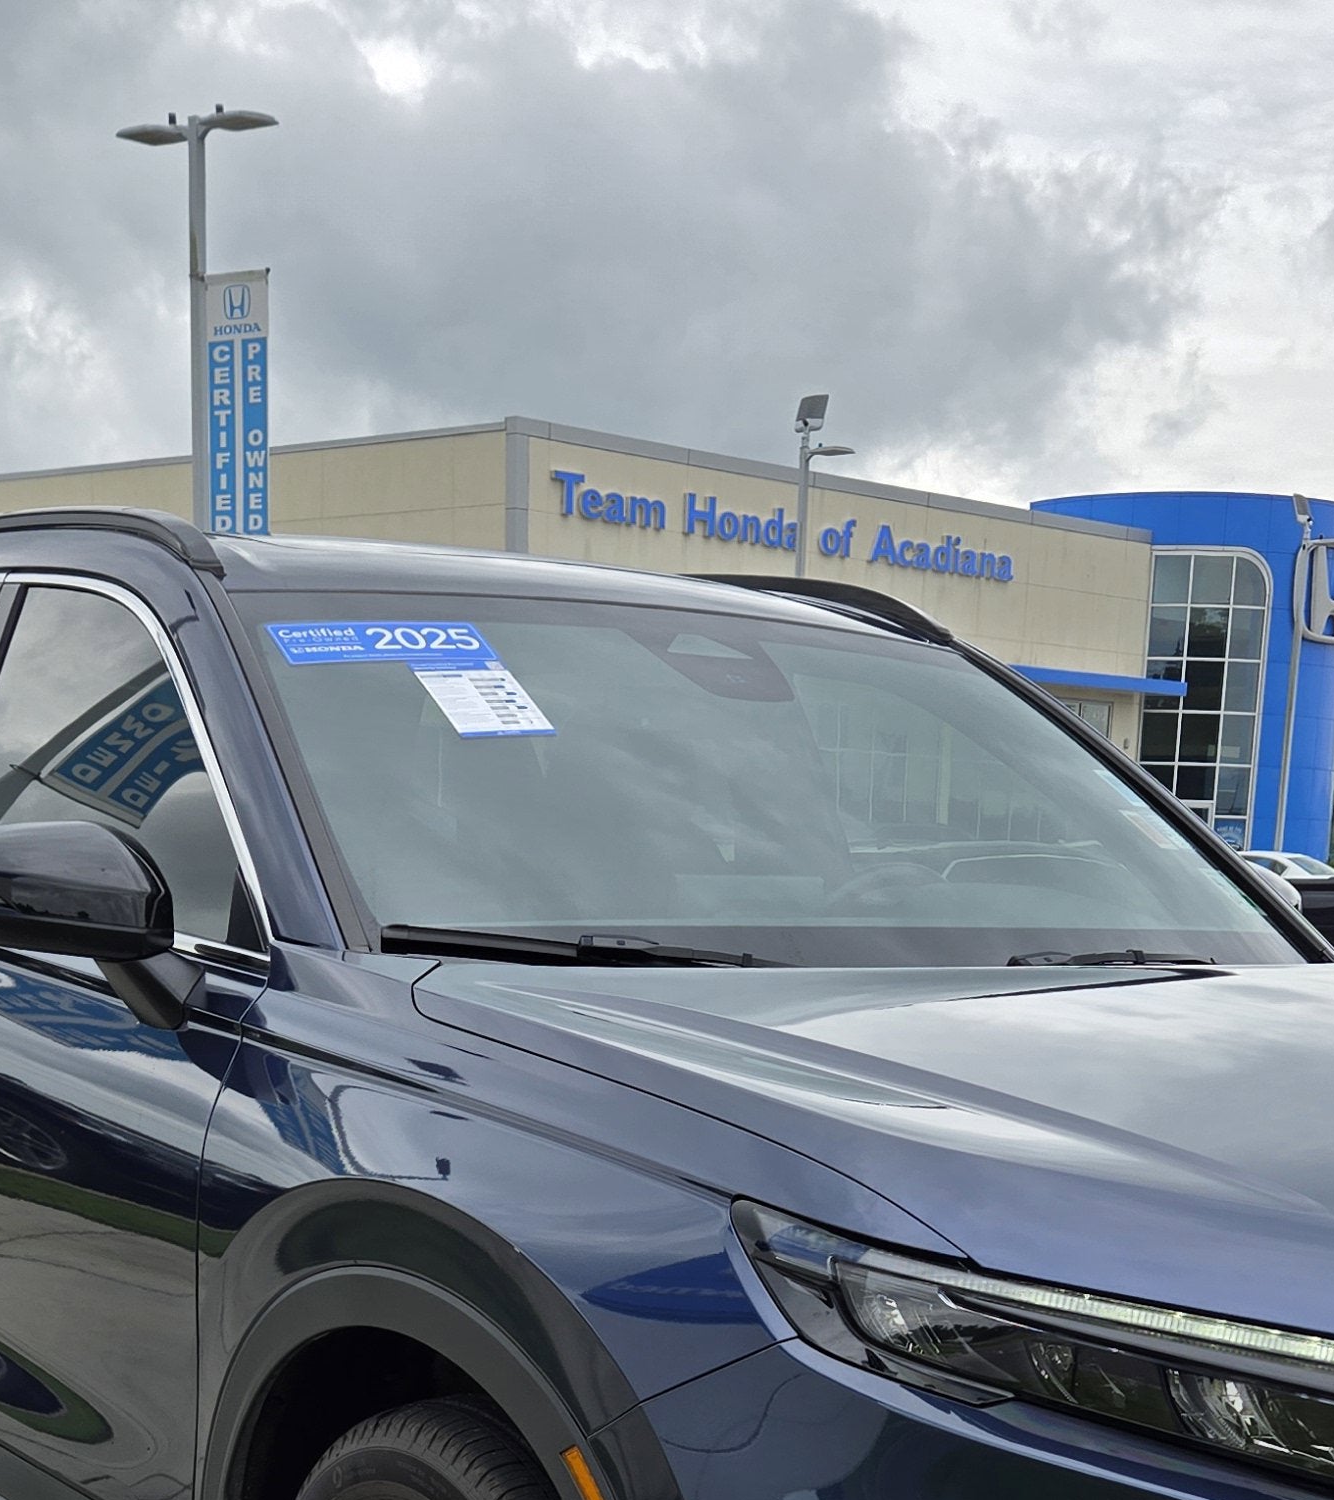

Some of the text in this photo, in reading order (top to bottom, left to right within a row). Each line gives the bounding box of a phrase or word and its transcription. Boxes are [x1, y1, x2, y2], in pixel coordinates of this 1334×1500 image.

[213, 322, 262, 336] HONDA
[212, 345, 233, 532] CERTIFIED
[245, 342, 266, 531] PRE OWNED
[550, 469, 666, 531] Team
[819, 518, 857, 559] of
[870, 523, 1014, 583] Acadiana
[277, 627, 355, 639] Certified
[365, 626, 481, 651] 2025
